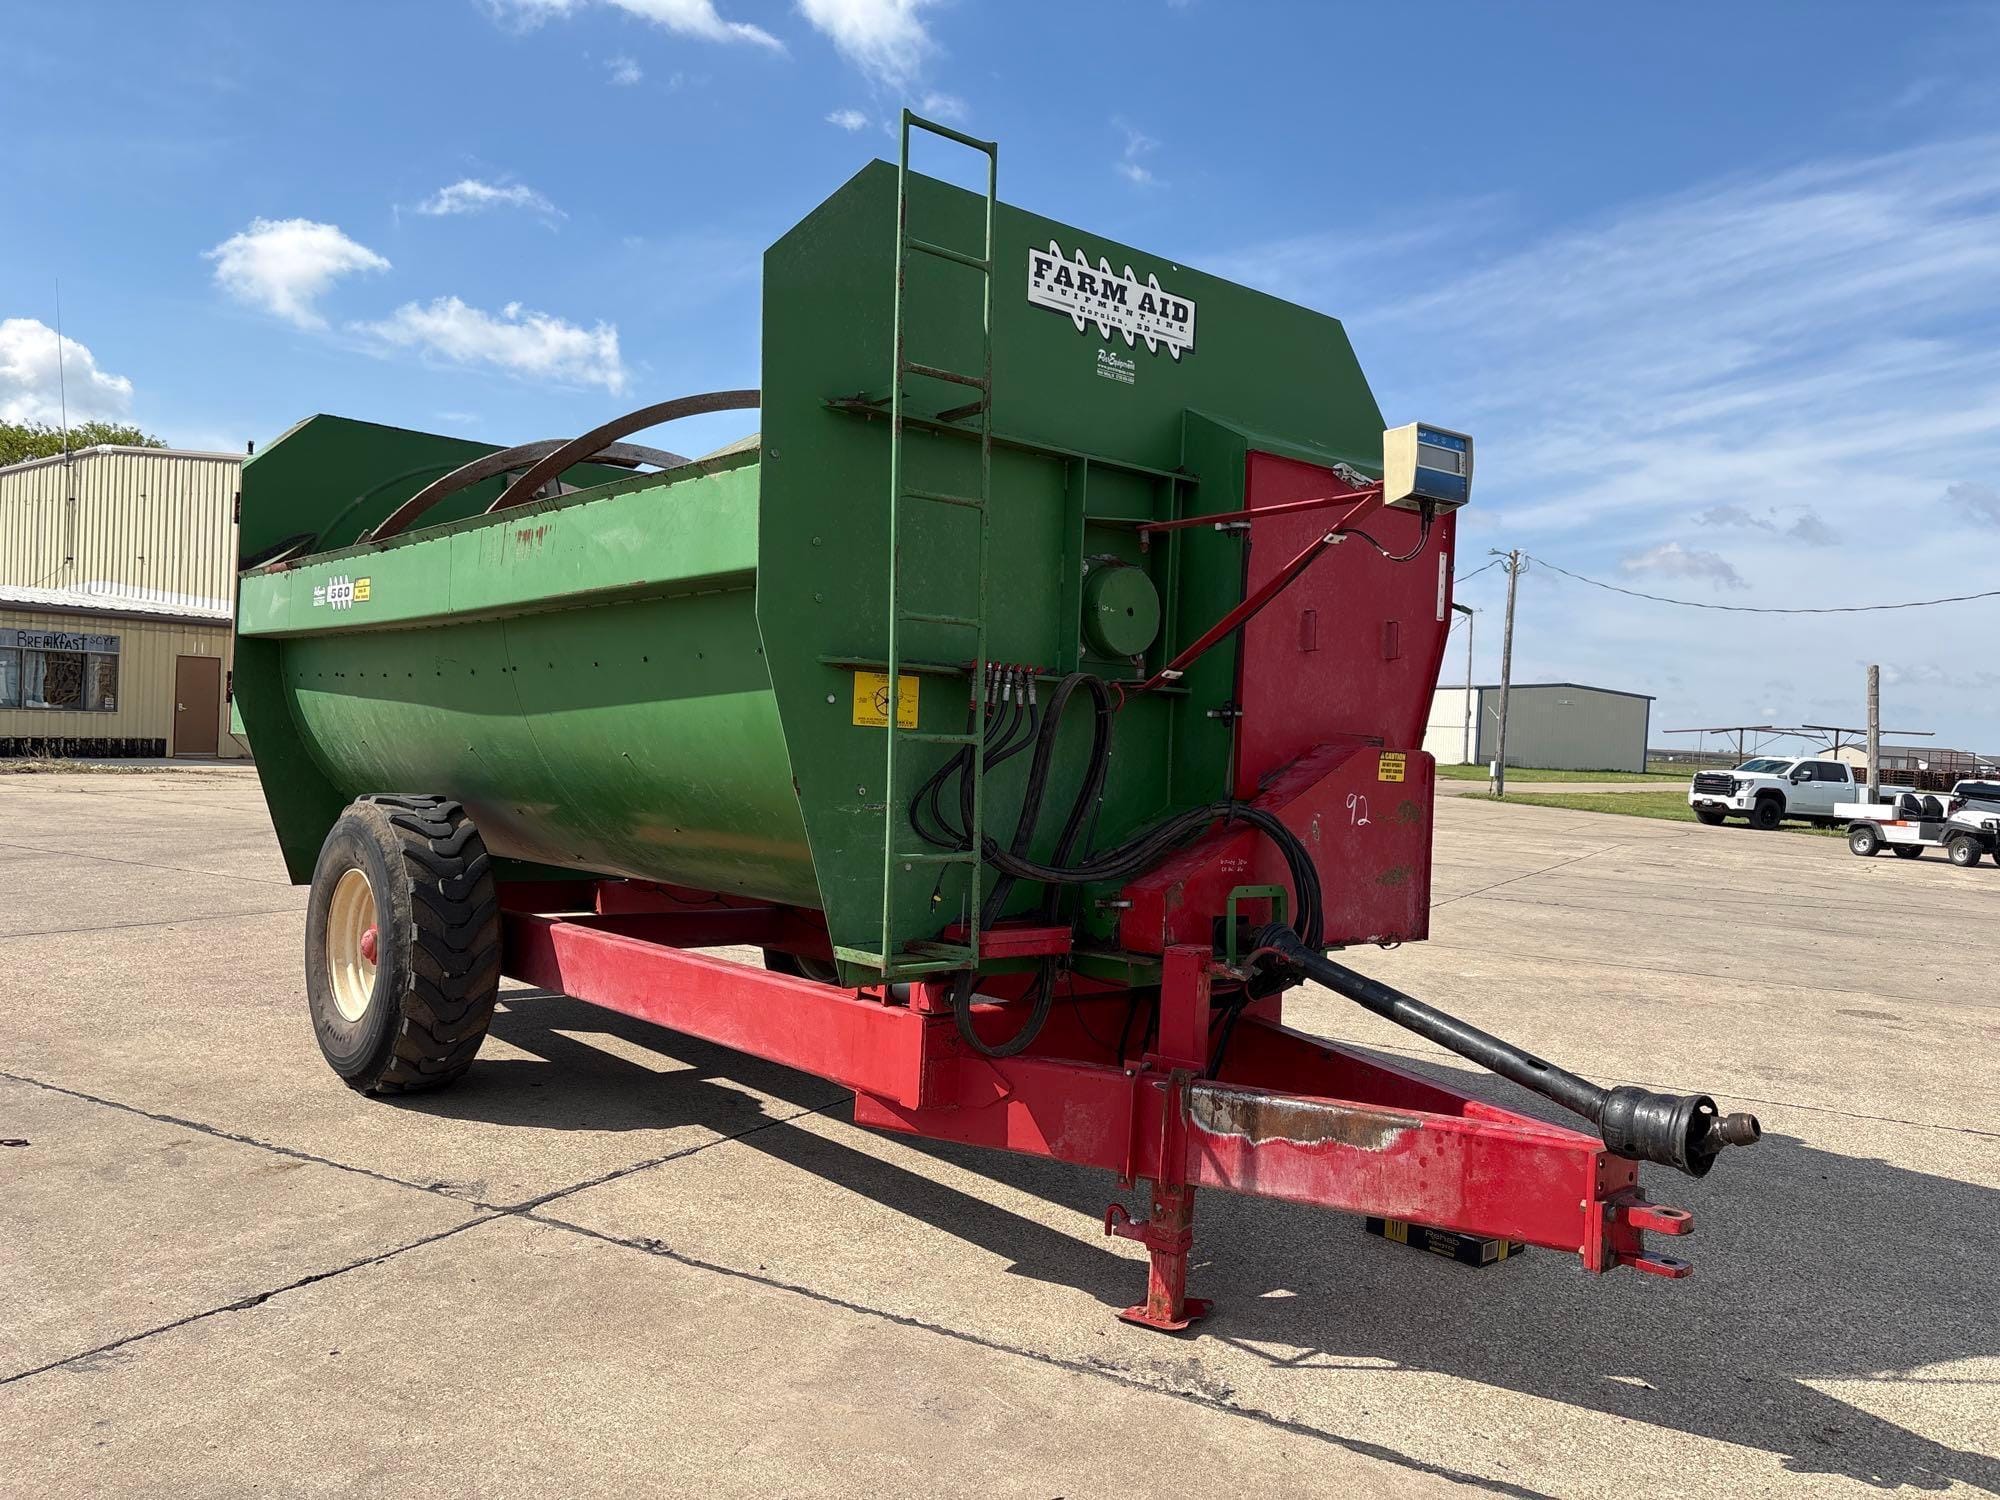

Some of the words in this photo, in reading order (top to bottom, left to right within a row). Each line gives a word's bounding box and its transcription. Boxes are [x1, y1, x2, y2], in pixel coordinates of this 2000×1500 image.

[1033, 256, 1127, 305] FARM
[1138, 292, 1188, 323] AID
[1136, 323, 1150, 332] SD
[1156, 318, 1187, 334] INC.
[331, 586, 350, 599] 560
[1346, 793, 1371, 826] 92
[1425, 1230, 1460, 1246] Rehab
